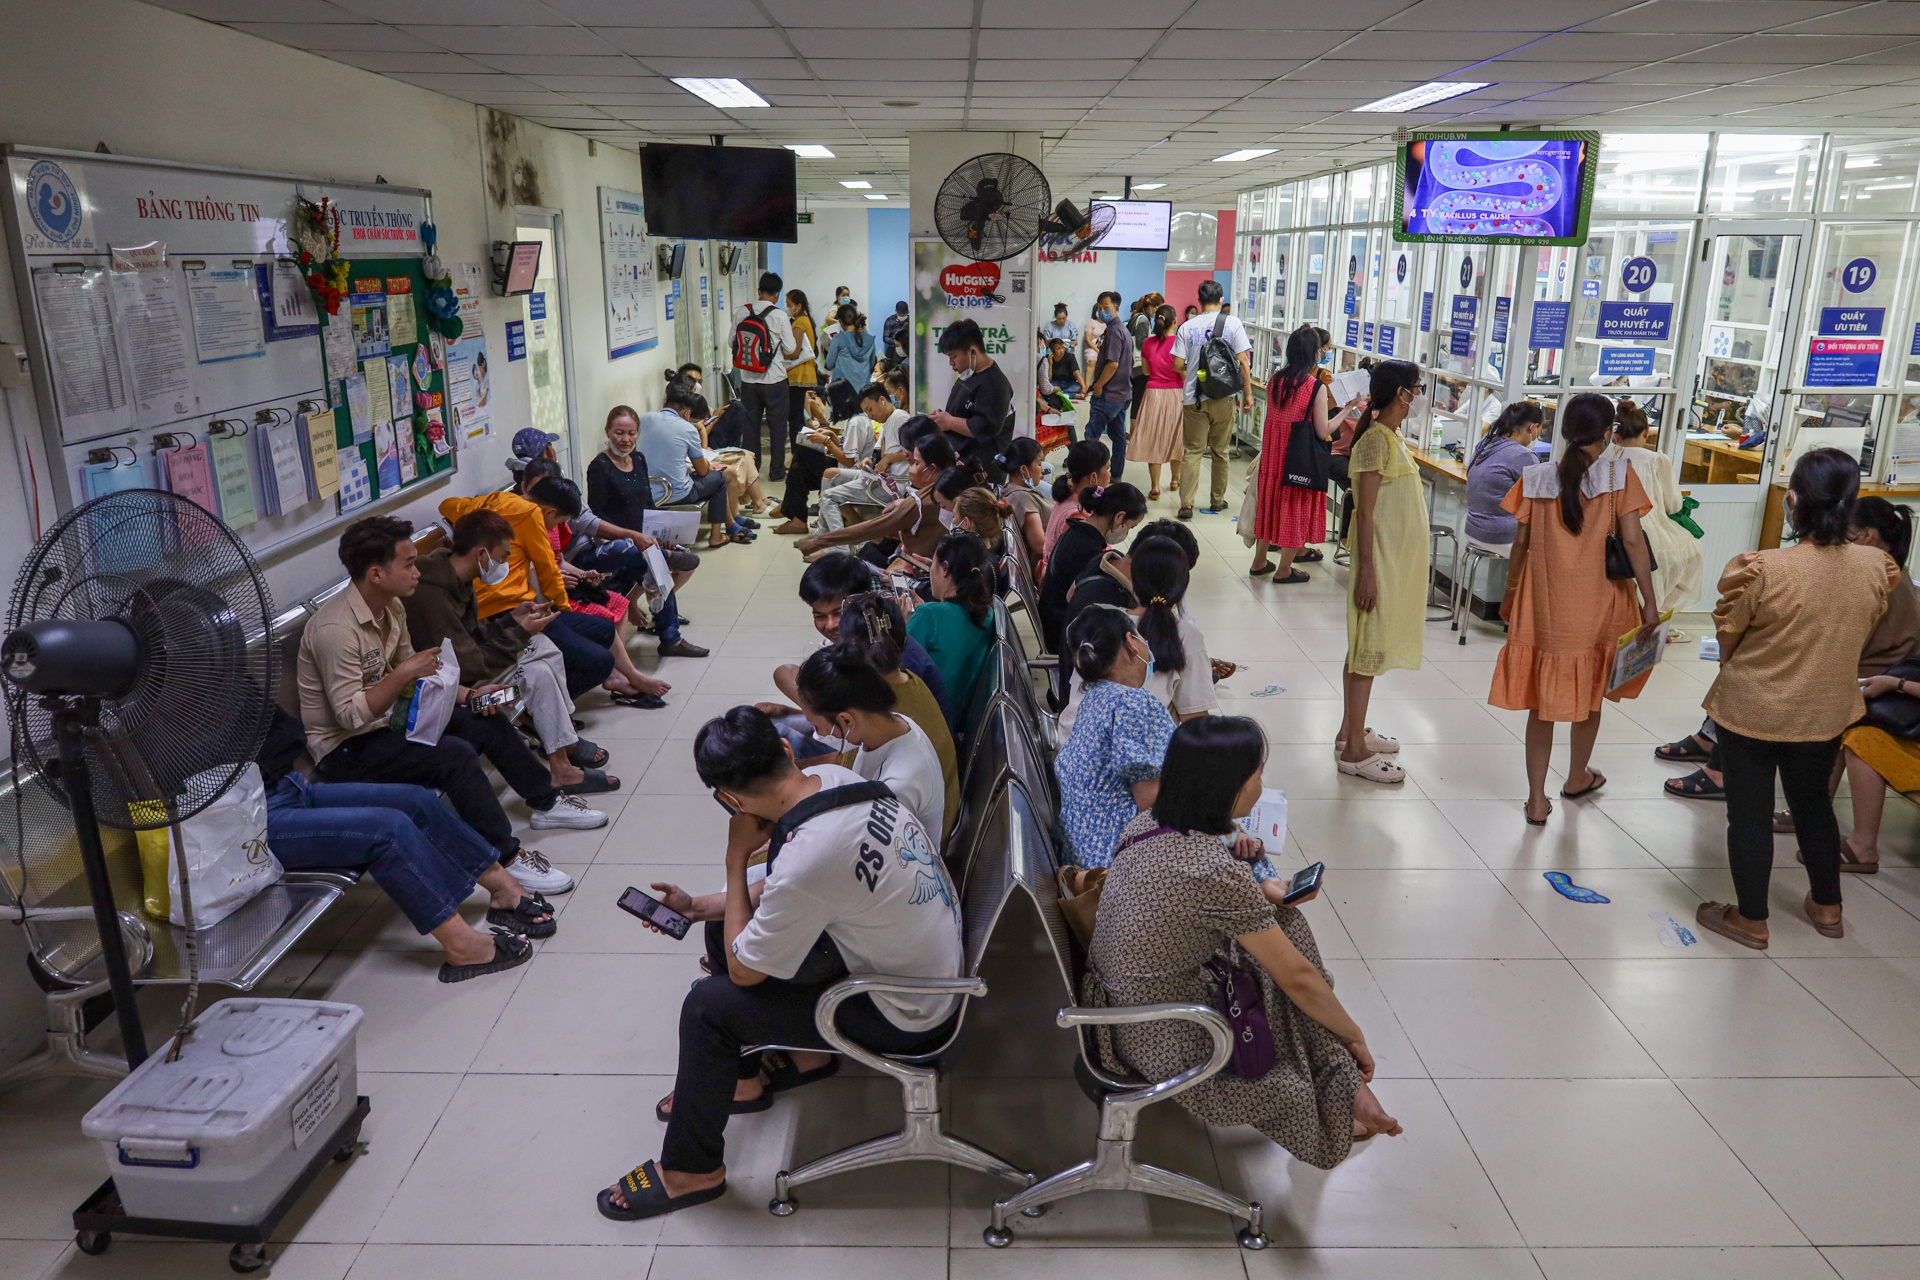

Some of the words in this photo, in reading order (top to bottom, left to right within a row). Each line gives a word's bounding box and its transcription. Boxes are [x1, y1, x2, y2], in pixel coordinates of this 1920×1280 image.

[1416, 132, 1467, 140] MEDIHUB.VN
[136, 190, 182, 219] BẢNG
[184, 195, 235, 221] THÔNG
[238, 203, 261, 222] TIN
[385, 209, 413, 228] THÔNG
[1409, 209, 1417, 218] 4
[1439, 212, 1476, 220] BACILLUS
[945, 273, 995, 286] HUGGIES
[1462, 264, 1470, 280] 21
[1627, 265, 1651, 285] 20
[1849, 266, 1871, 286] 19
[963, 286, 977, 295] Dry
[947, 294, 965, 309] lọt
[967, 295, 993, 309] lòng
[981, 323, 1009, 338] TRÀ
[1604, 320, 1619, 329] ĐO
[1619, 318, 1651, 329] HUYẾT
[1651, 319, 1665, 329] ÁP
[1848, 322, 1868, 331] TIÊN
[855, 842, 884, 894] 2S
[294, 1107, 309, 1126] KHOA
[309, 1088, 326, 1110] PHÒNG
[314, 1102, 323, 1115] KHI
[625, 1171, 638, 1192] ouse
[634, 1164, 652, 1189] rew
